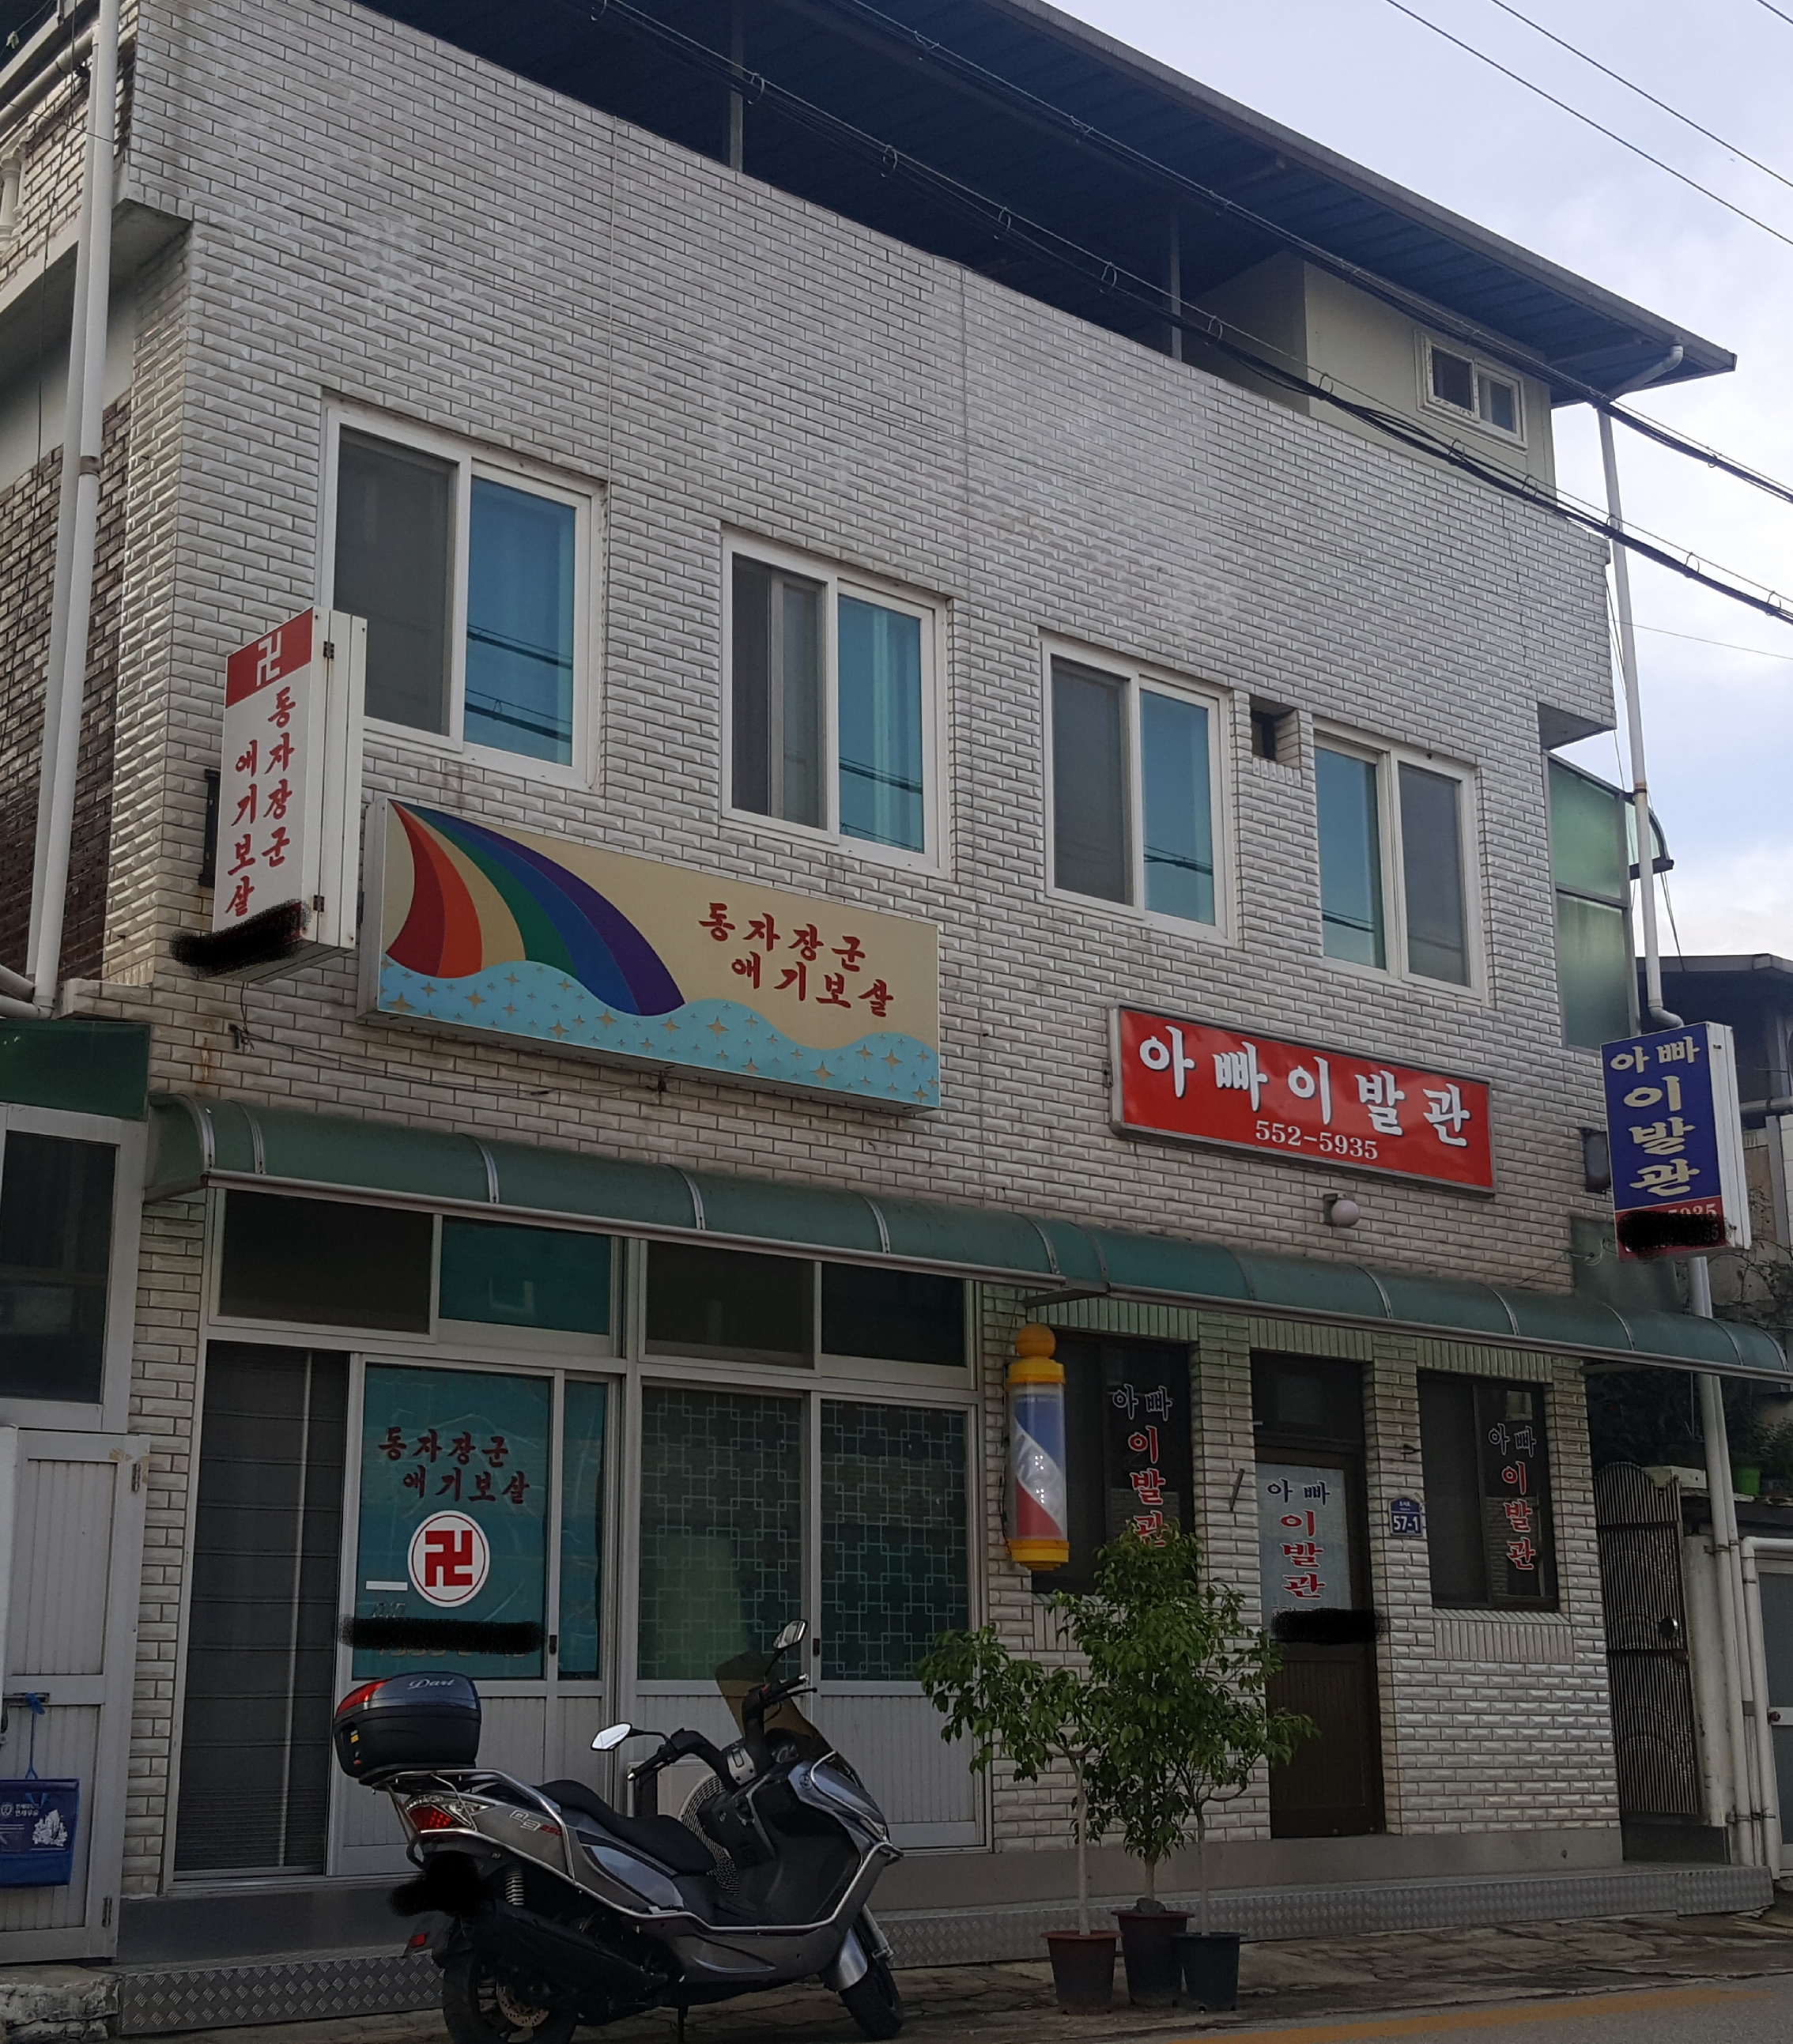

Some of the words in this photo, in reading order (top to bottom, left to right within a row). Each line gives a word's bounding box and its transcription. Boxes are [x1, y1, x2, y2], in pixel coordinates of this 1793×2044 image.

[262, 686, 296, 867] 동자장군
[225, 739, 258, 916] 애기보살
[698, 902, 866, 972] 동자장군
[731, 951, 893, 1017] 애기보살
[1610, 1036, 1700, 1073] 아빠
[1255, 1120, 1379, 1160] 552-5935
[1624, 1075, 1700, 1197] 이발관
[1112, 1383, 1173, 1421] 아빠
[378, 1427, 508, 1468] 동자장군
[1488, 1423, 1537, 1458] 아빠
[402, 1465, 530, 1504] 애기보살
[1266, 1478, 1331, 1507] 아빠
[1393, 1515, 1418, 1531] 57-1
[1502, 1461, 1536, 1570] 이발관
[1280, 1510, 1326, 1600] 이발관
